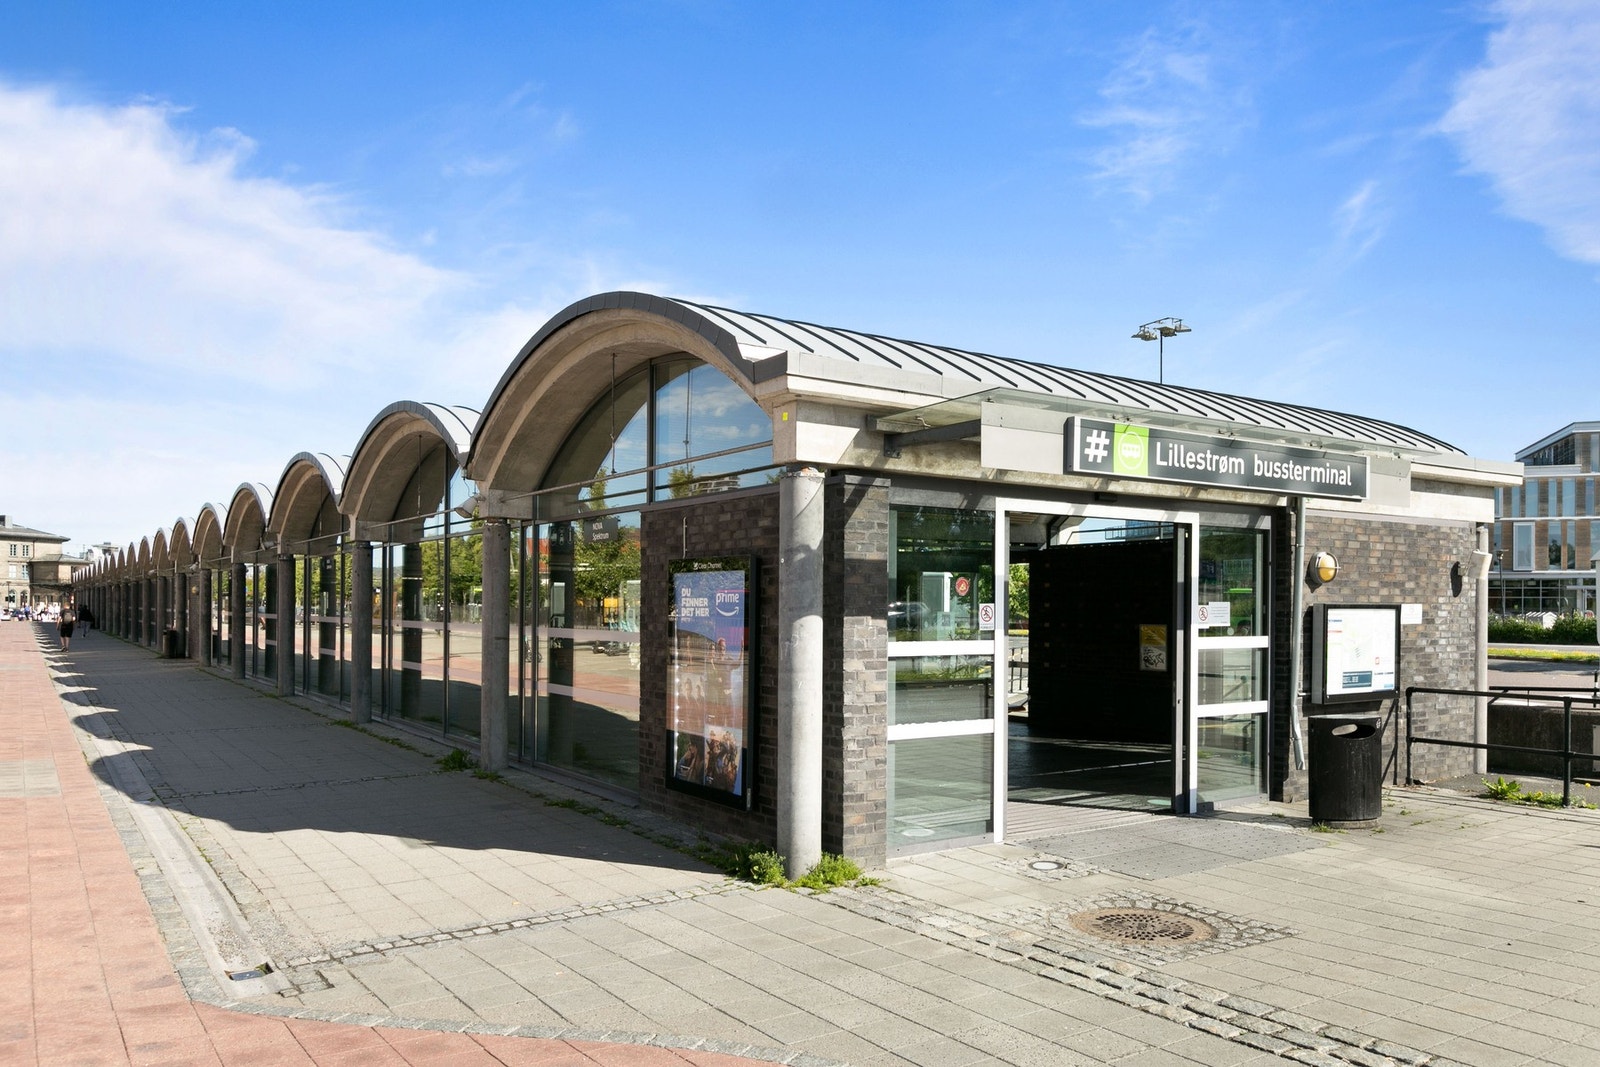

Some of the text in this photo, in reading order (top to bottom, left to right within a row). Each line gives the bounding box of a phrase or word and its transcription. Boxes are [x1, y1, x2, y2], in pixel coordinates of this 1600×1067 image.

[1156, 441, 1245, 475] Lillestrøm
[1254, 453, 1352, 486] bussterminal
[681, 588, 691, 597] DU
[715, 590, 739, 606] prime
[681, 607, 709, 617] DET HER
